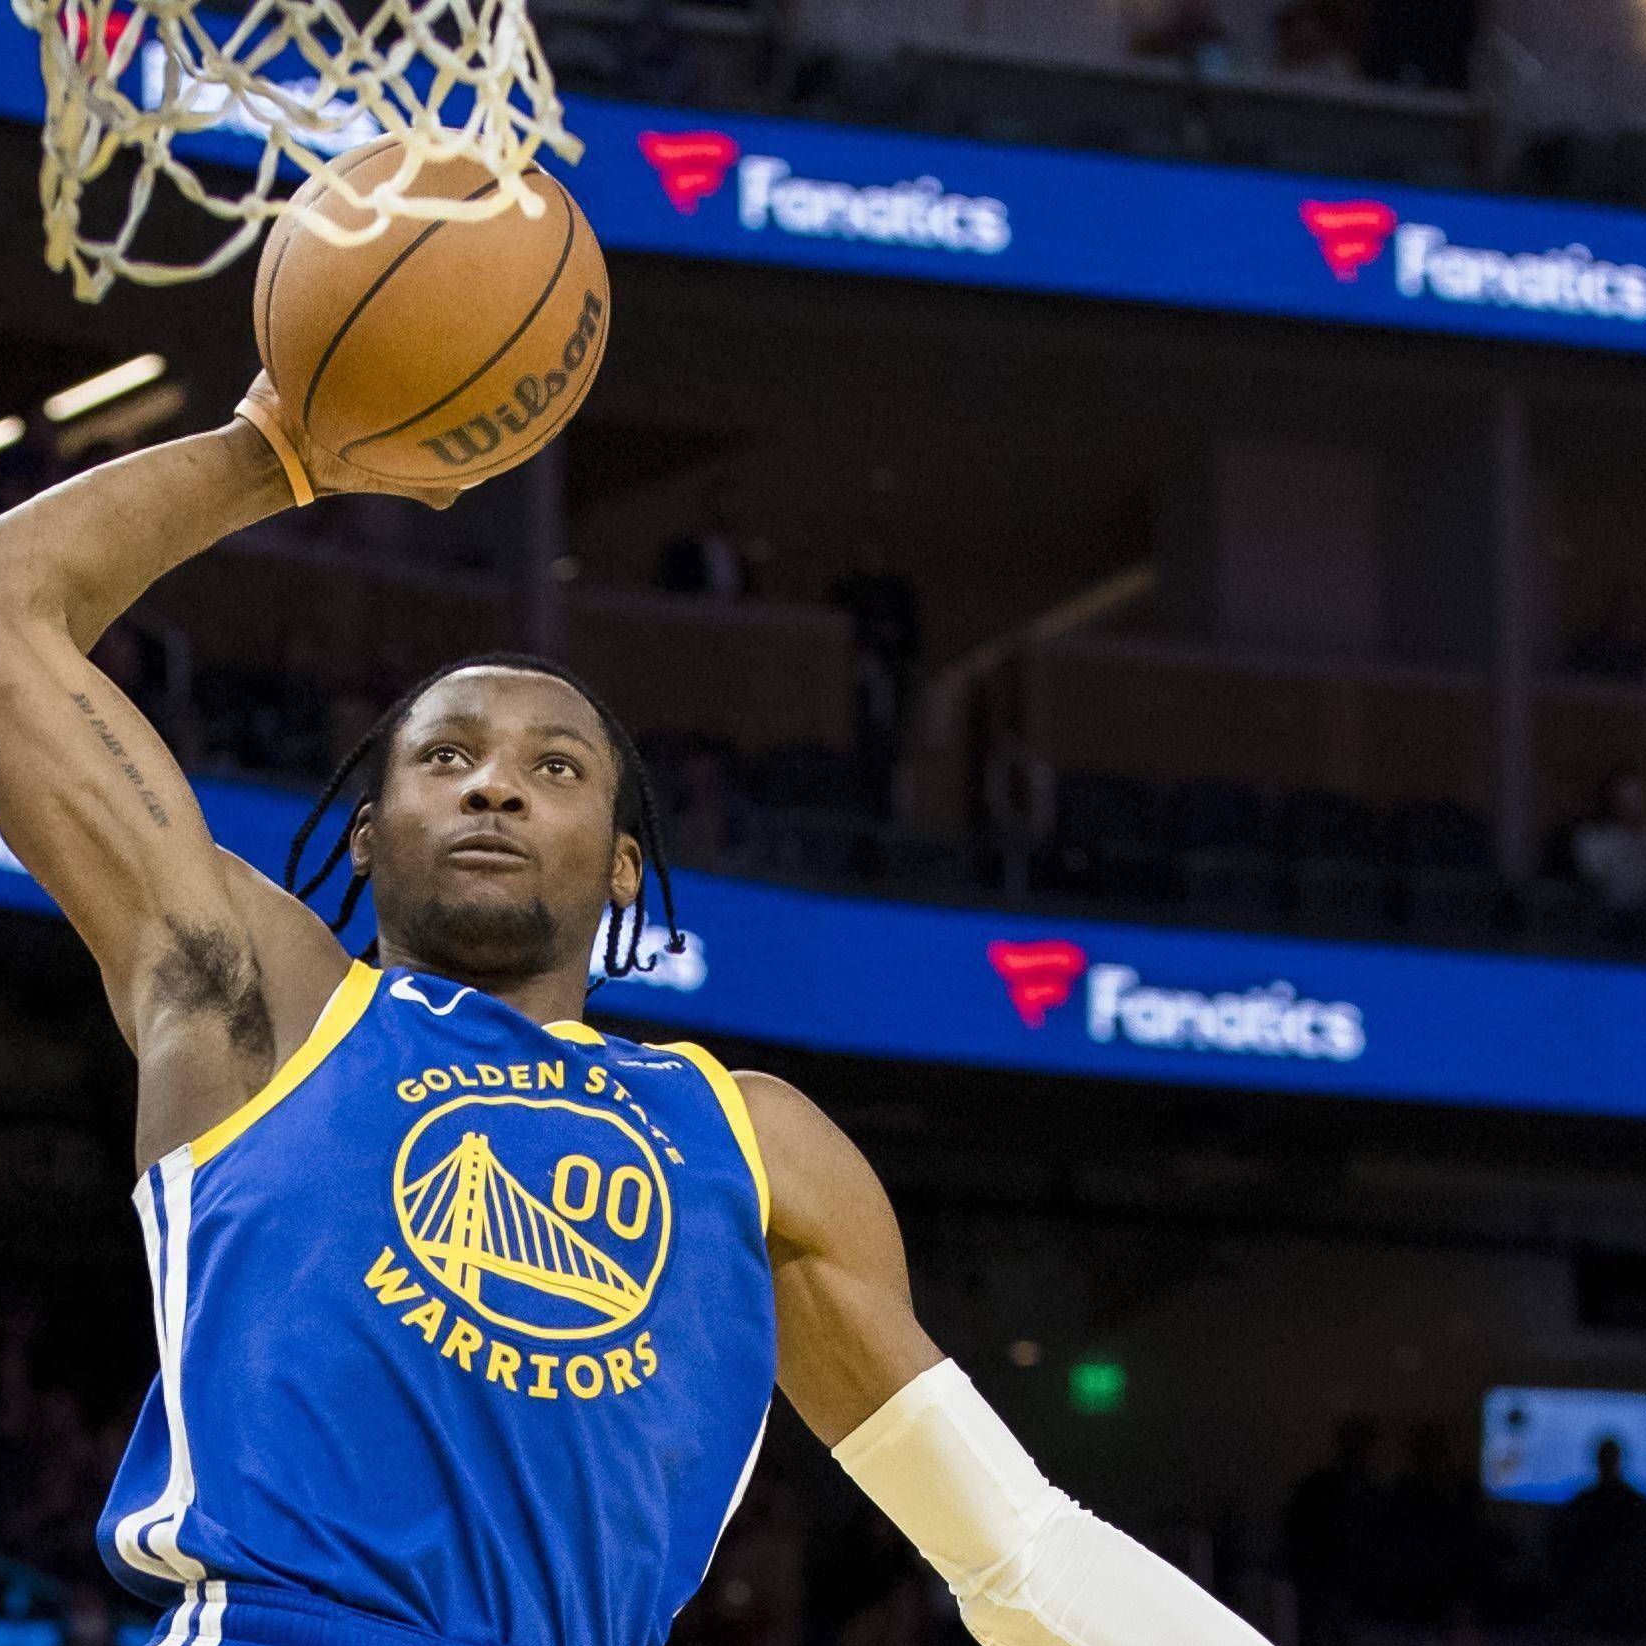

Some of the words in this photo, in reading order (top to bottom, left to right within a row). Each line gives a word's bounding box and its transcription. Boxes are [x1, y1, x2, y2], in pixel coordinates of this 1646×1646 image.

[739, 155, 1009, 253] Fanatics
[417, 290, 603, 466] Wilson
[1088, 964, 1365, 1061] Fanatics
[397, 1060, 564, 1103] GOLDEN
[552, 1154, 652, 1240] 00
[363, 1246, 657, 1399] WARRIORS
